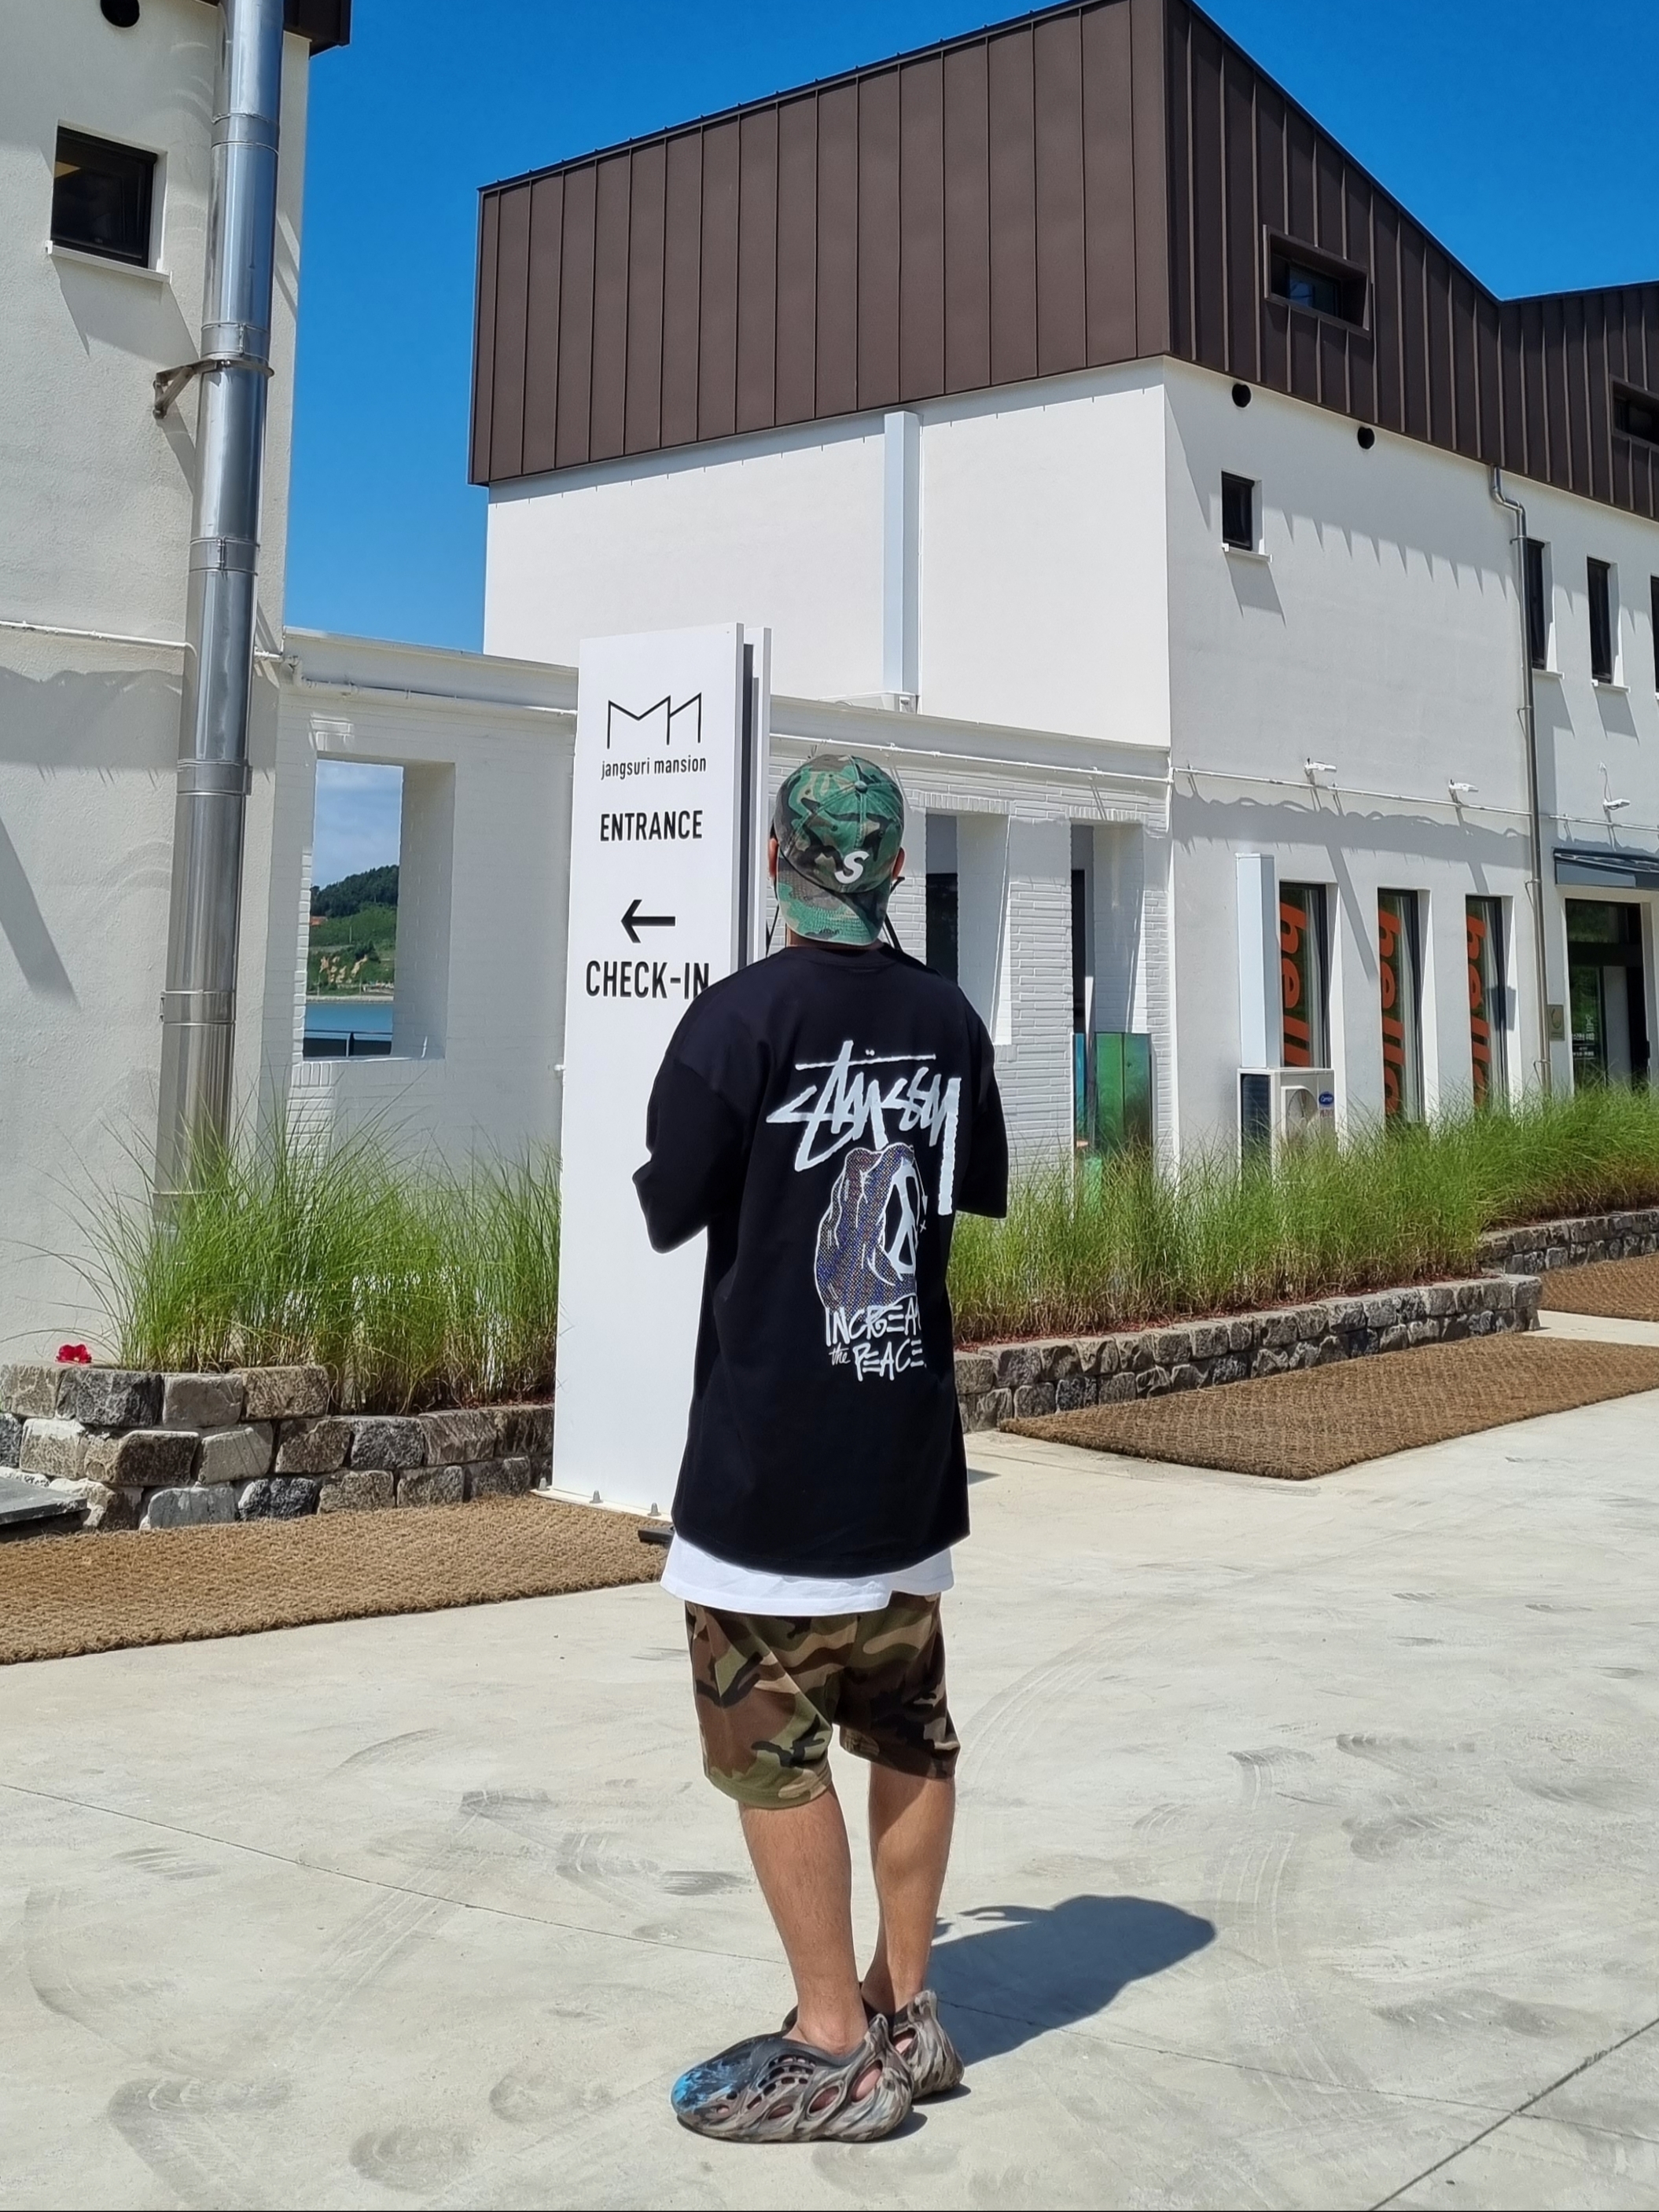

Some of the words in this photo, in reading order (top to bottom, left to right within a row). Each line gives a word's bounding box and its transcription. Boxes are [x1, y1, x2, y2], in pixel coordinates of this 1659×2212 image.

[601, 757, 650, 781] jangsuri
[654, 755, 706, 775] mansion
[600, 810, 704, 842] ENTRANCE
[834, 851, 870, 884] S
[586, 960, 710, 1001] CHECK-IN
[1280, 901, 1311, 1068] hell
[825, 1297, 921, 1347] INCREA
[828, 1342, 851, 1366] the
